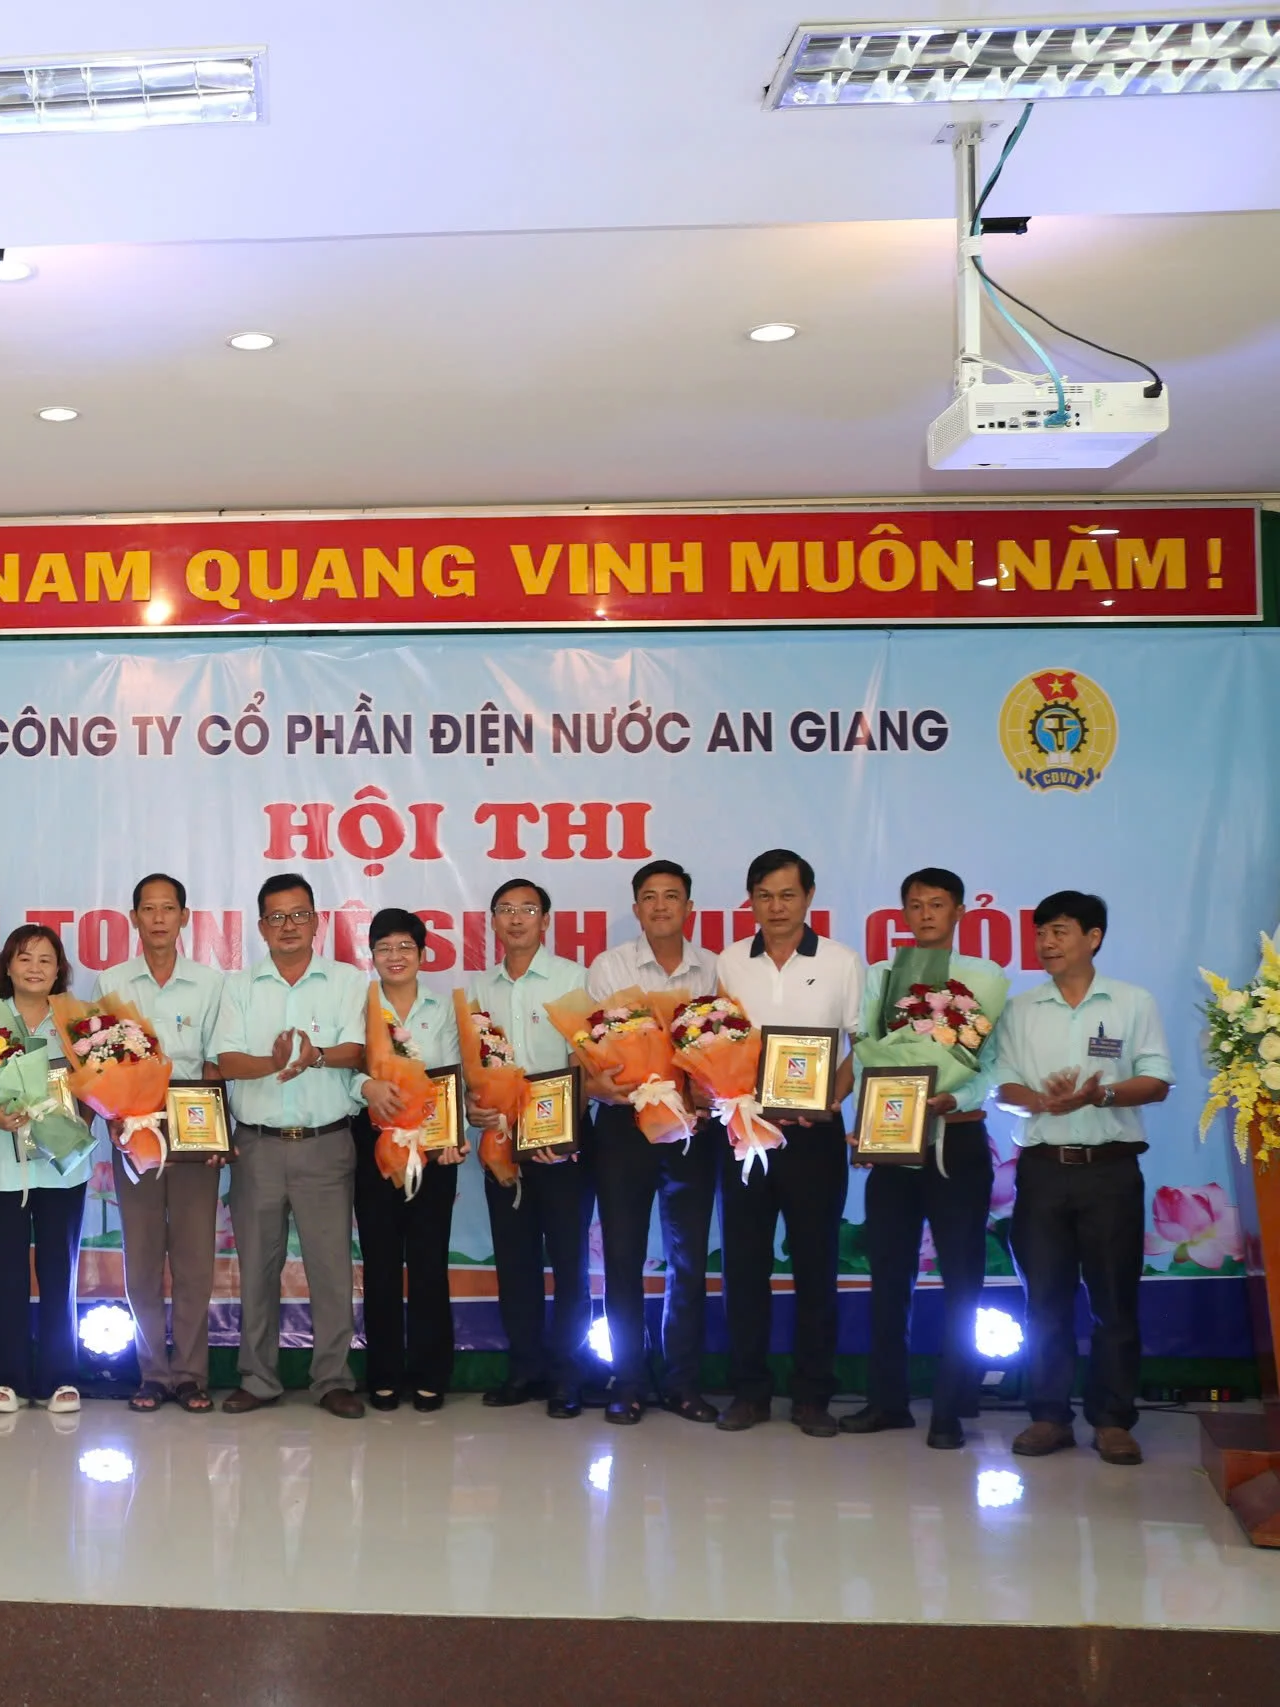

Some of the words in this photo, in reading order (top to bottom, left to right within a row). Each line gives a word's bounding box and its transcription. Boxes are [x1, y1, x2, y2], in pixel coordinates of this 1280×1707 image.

[185, 544, 476, 610] QUANG
[510, 542, 704, 596] VINH
[730, 523, 974, 592] MUÔN
[997, 523, 1188, 592] NĂM
[131, 715, 182, 756] TY
[196, 690, 270, 757] CỔ
[287, 692, 413, 755] PHẦN
[429, 701, 534, 767] ĐIỆN
[552, 699, 691, 754] NƯỚC
[706, 711, 773, 753] AN
[789, 709, 950, 752] GIANG
[263, 784, 445, 877] HỘI
[474, 802, 653, 860] THI
[412, 910, 607, 972] SIH
